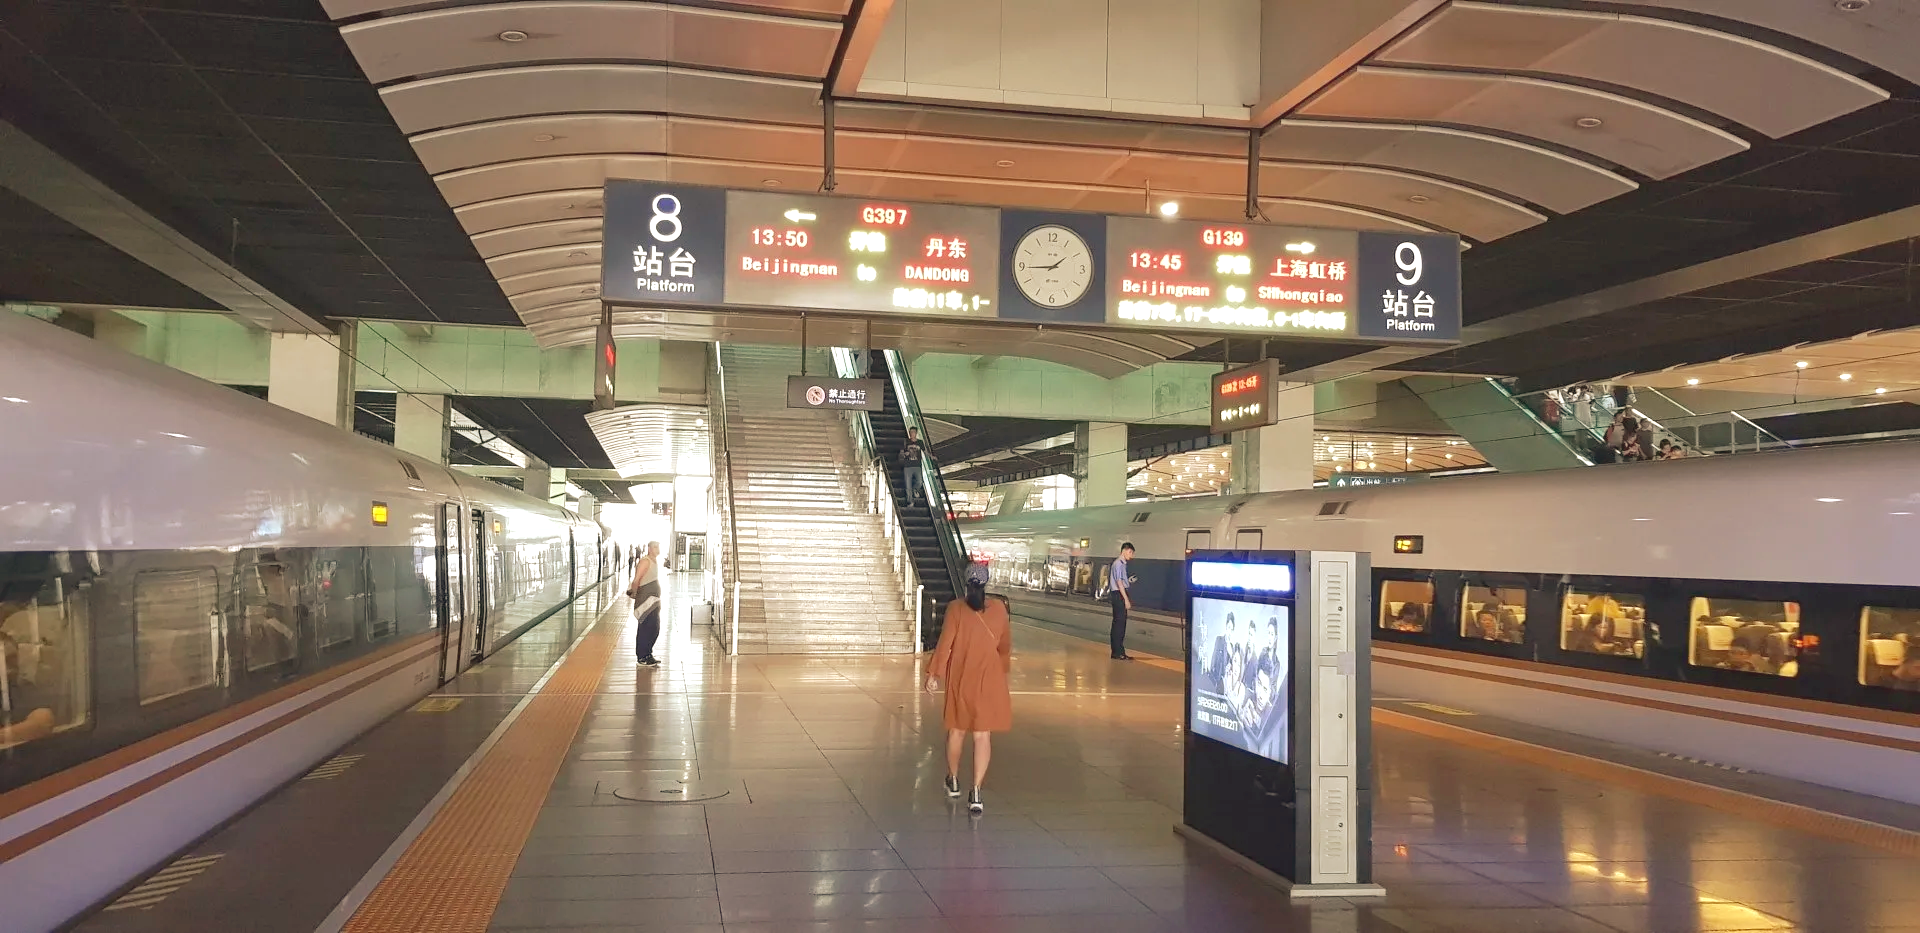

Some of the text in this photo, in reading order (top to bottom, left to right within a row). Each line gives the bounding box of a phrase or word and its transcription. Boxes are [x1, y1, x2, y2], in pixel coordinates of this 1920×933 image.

[649, 193, 682, 242] 8
[863, 207, 908, 226] G397
[752, 229, 808, 248] 13:50
[1048, 233, 1058, 243] 12
[1204, 229, 1244, 246] G139
[926, 238, 967, 258] 丹东
[633, 245, 697, 278] 站台
[743, 256, 838, 277] Beijingnan
[1018, 262, 1025, 271] 9
[1080, 265, 1086, 274] 3
[1131, 252, 1181, 270] 13:45
[1271, 259, 1347, 281] 上海虹桥
[1394, 242, 1423, 286] 9
[905, 265, 969, 283] DANDONG
[637, 278, 695, 293] Platform
[1122, 280, 1210, 298] Beijingnan
[1049, 294, 1055, 304] 6
[1383, 290, 1436, 318] 站台
[1386, 318, 1436, 332] Platform
[829, 389, 866, 400] 禁止通行
